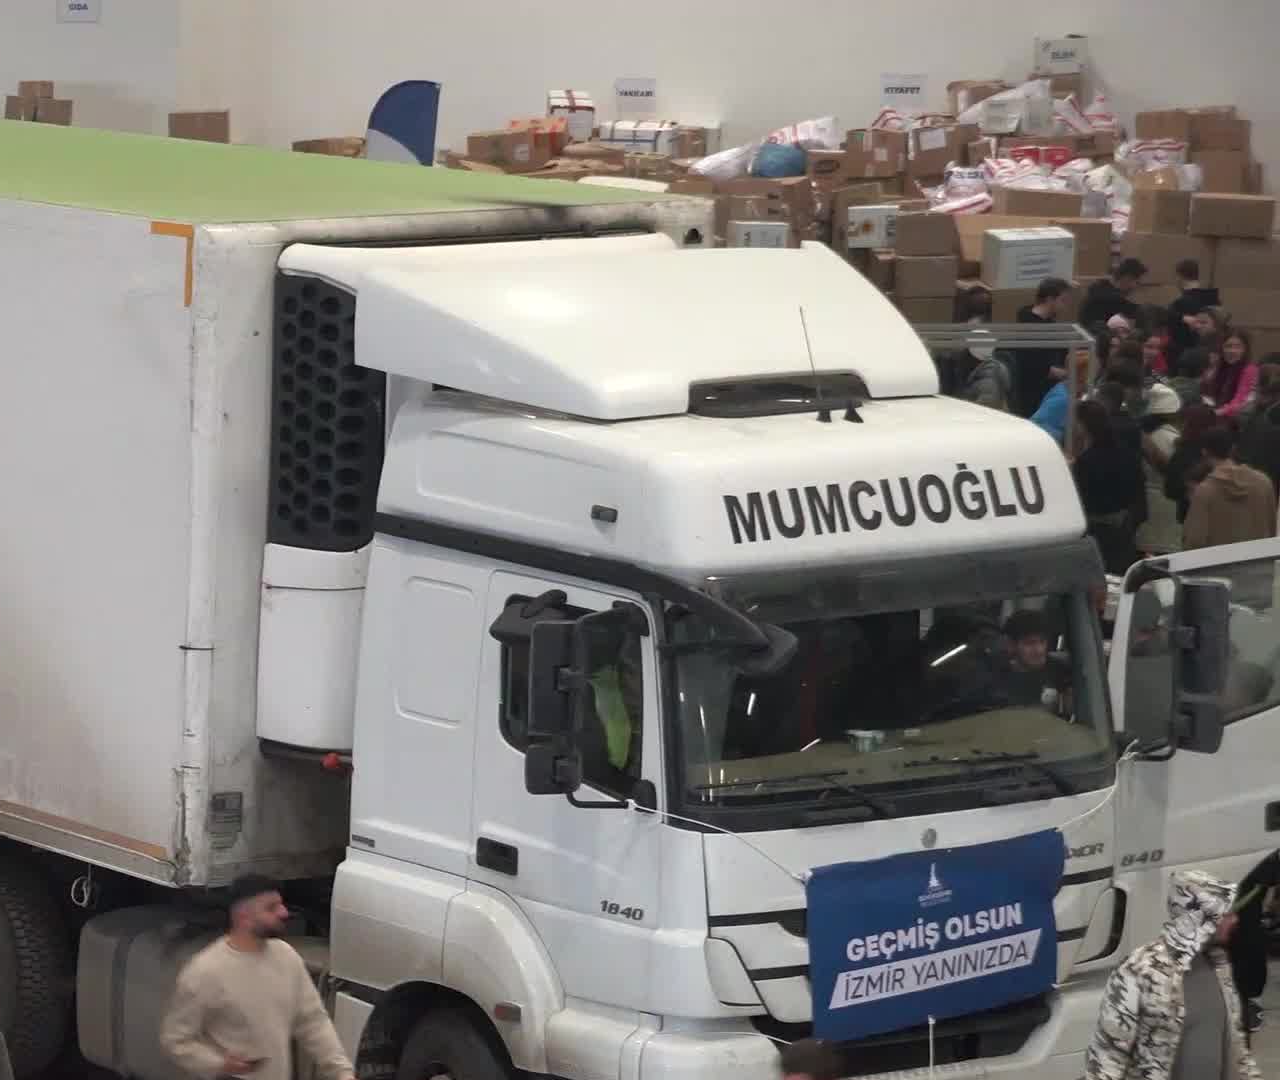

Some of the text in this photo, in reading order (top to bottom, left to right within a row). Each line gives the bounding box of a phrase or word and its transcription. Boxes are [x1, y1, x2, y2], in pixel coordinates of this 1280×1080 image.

[723, 462, 1045, 545] MUMCUOĞLU
[600, 900, 644, 920] 1840
[846, 902, 1023, 962] GEÇMİŞ OLSUN
[844, 940, 1029, 1001] İZMİR YANINIZDA
